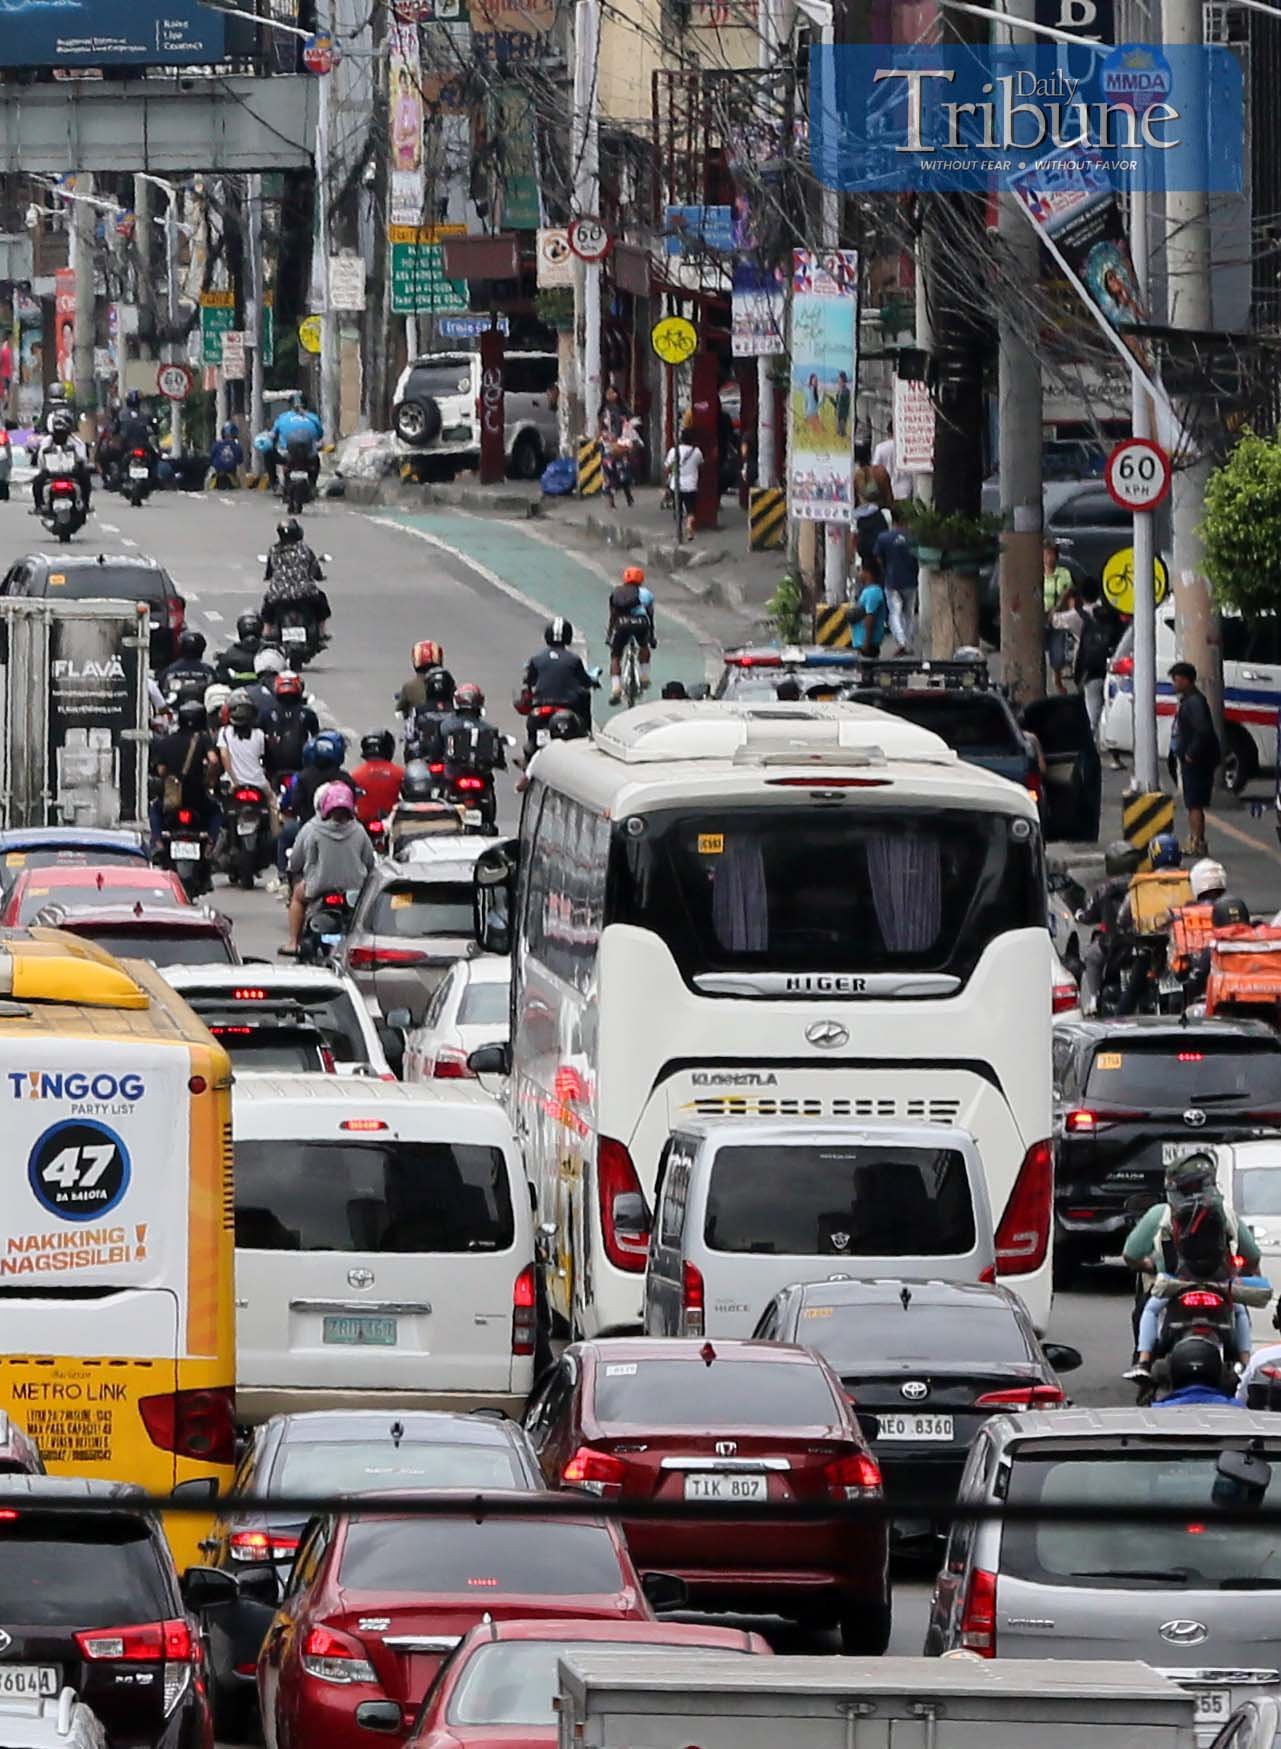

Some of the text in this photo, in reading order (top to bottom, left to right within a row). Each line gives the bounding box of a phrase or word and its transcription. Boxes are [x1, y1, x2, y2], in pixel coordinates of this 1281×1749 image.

[1106, 73, 1166, 91] MMDA
[577, 224, 602, 243] 60
[1119, 455, 1156, 481] 60
[786, 977, 867, 993] HIGER
[71, 1104, 136, 1116] PARTY LIST
[42, 1143, 116, 1189] 47
[7, 1227, 126, 1254] NAKIKINIG
[12, 1382, 128, 1402] METRO LINK
[915, 1419, 951, 1435] 8360
[692, 1480, 760, 1497] TIK 807
